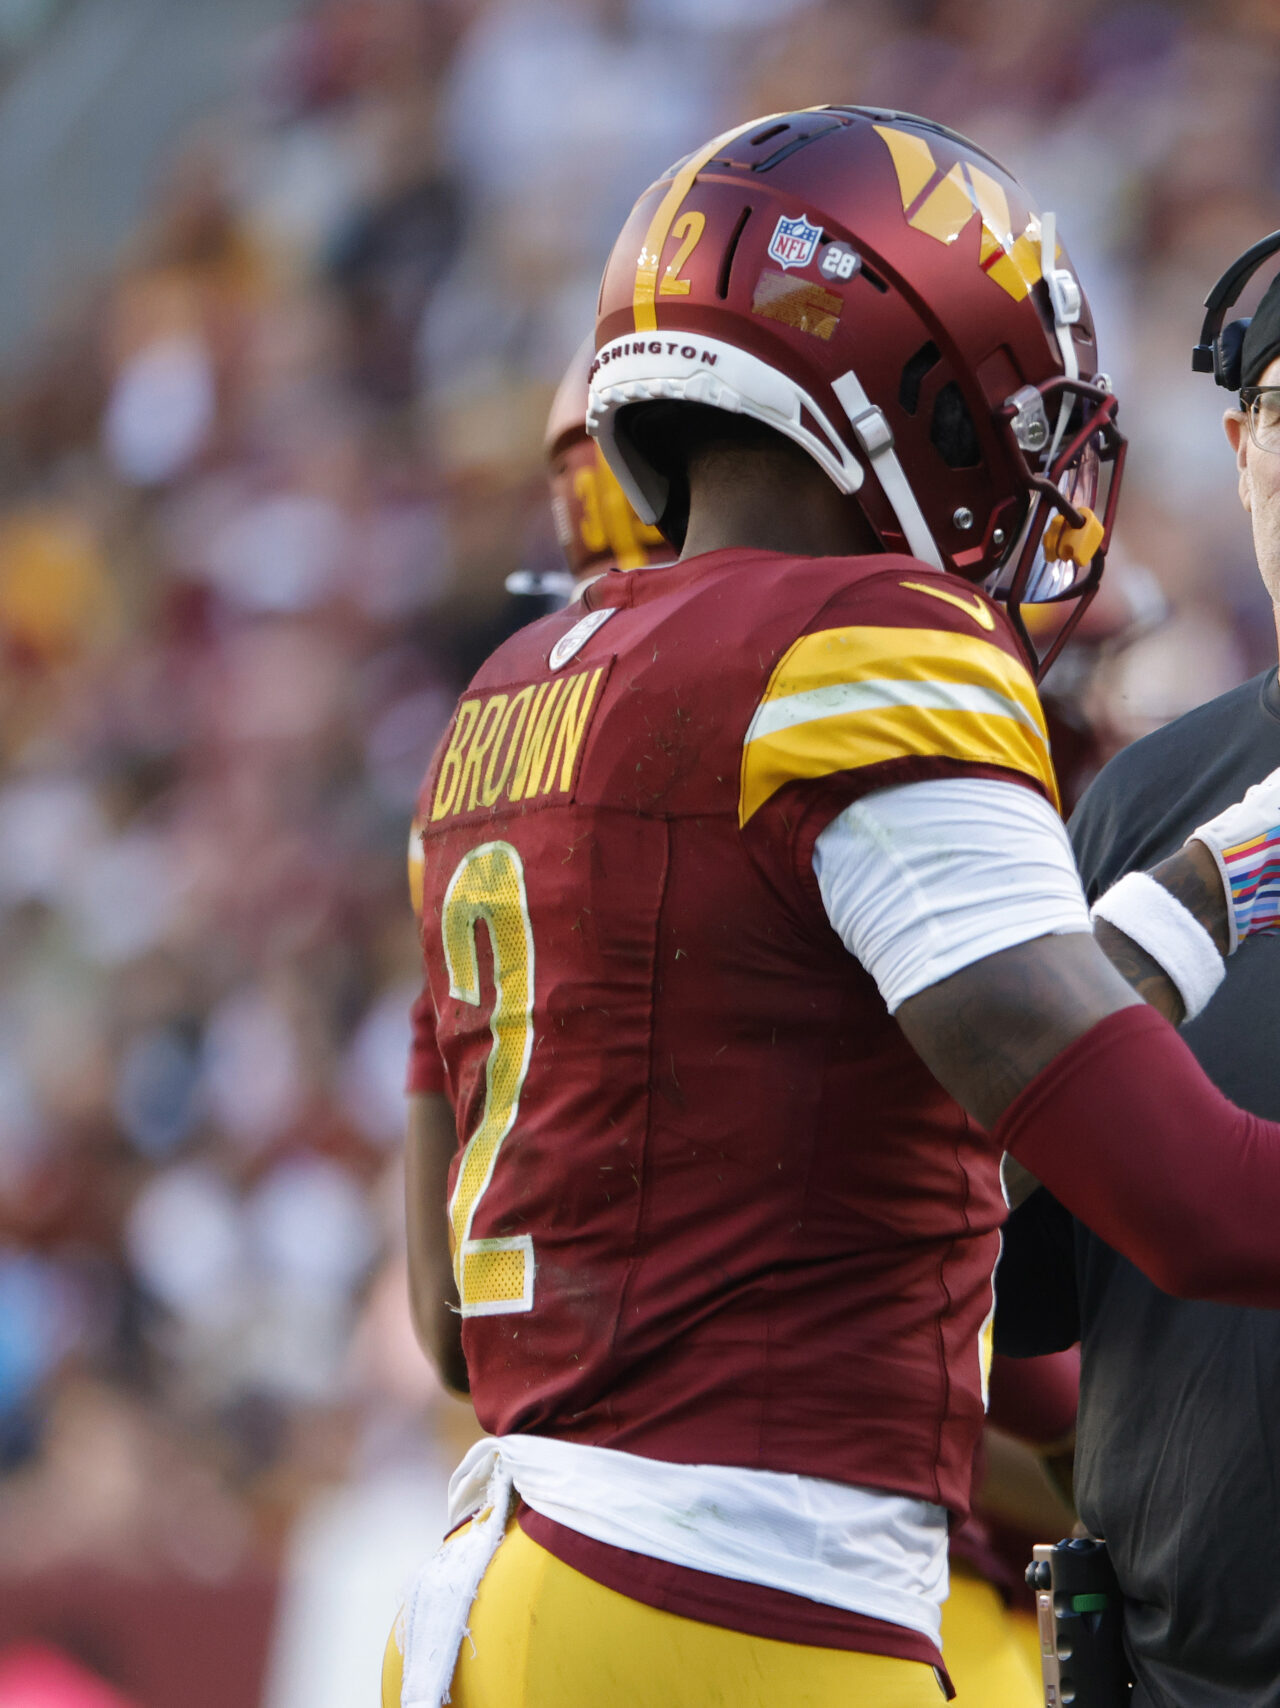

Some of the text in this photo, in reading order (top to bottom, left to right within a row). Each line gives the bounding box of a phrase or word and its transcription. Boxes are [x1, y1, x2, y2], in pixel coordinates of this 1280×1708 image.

[659, 211, 706, 295] 2
[775, 236, 806, 260] NFL
[822, 247, 856, 278] 28
[431, 667, 604, 822] BROWN
[442, 840, 535, 1317] 2
